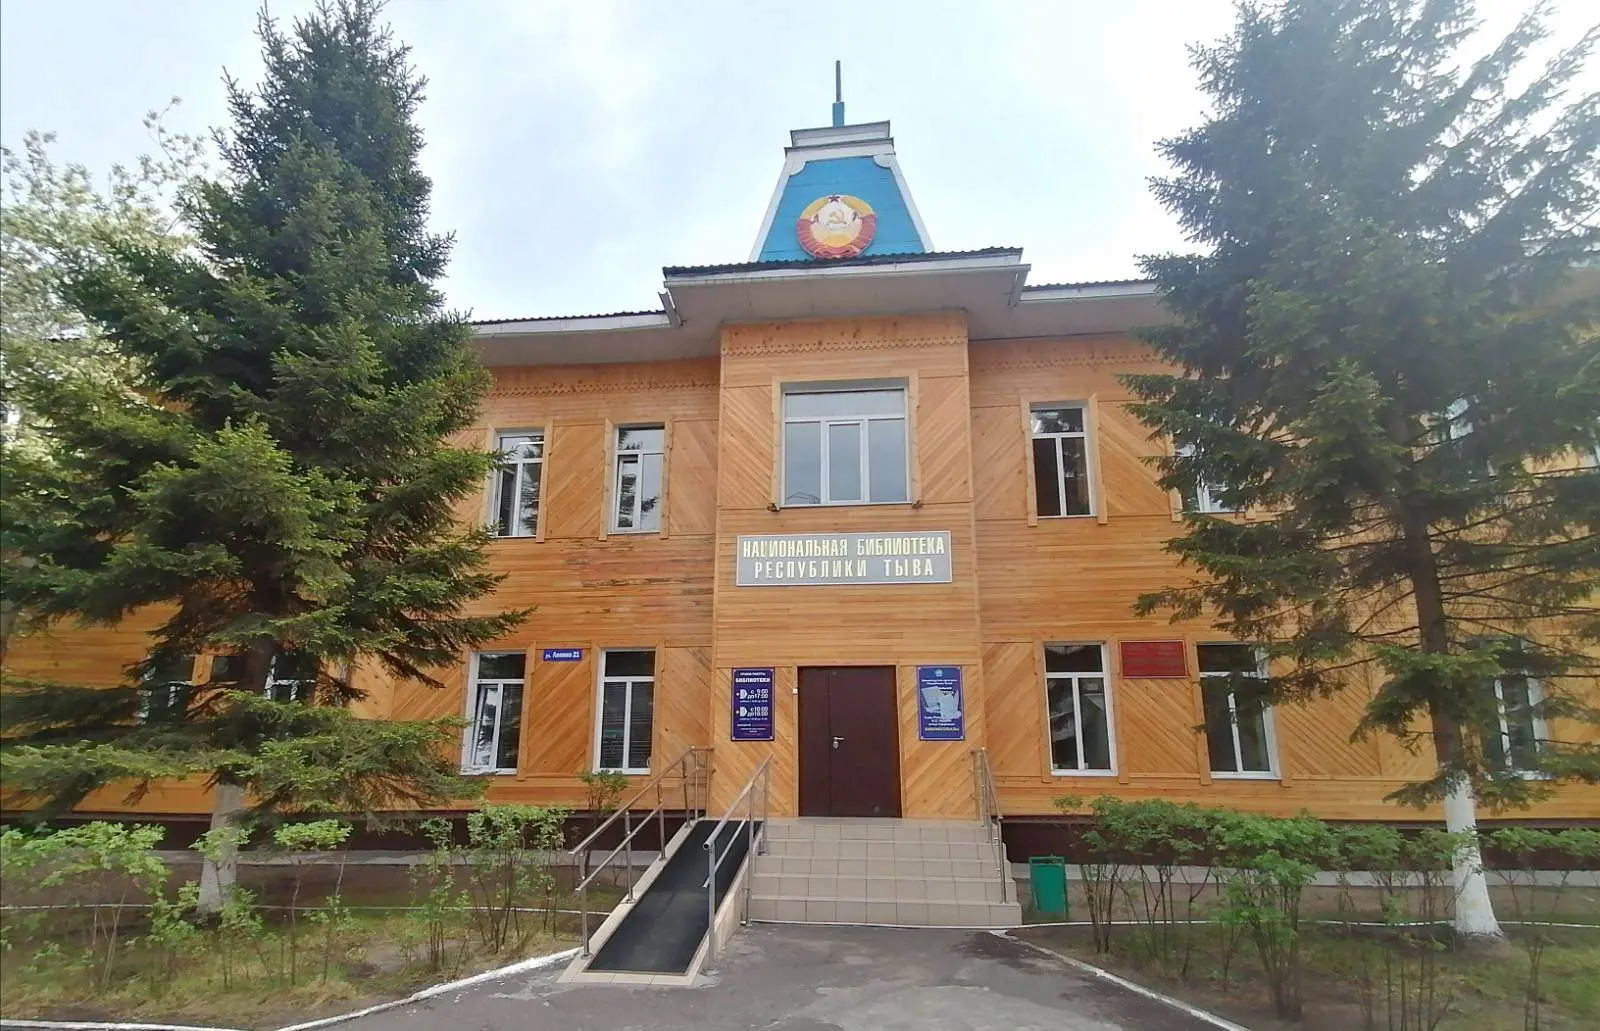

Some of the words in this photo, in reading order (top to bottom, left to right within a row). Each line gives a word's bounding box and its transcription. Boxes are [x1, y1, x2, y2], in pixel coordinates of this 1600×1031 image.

[743, 539, 848, 559] НАЦИОНАЛЬНАЯ
[857, 537, 945, 556] БИБЛИОТЕКА
[754, 560, 867, 579] РЕСПУБЛИКИ
[883, 558, 934, 577] ТЫВА
